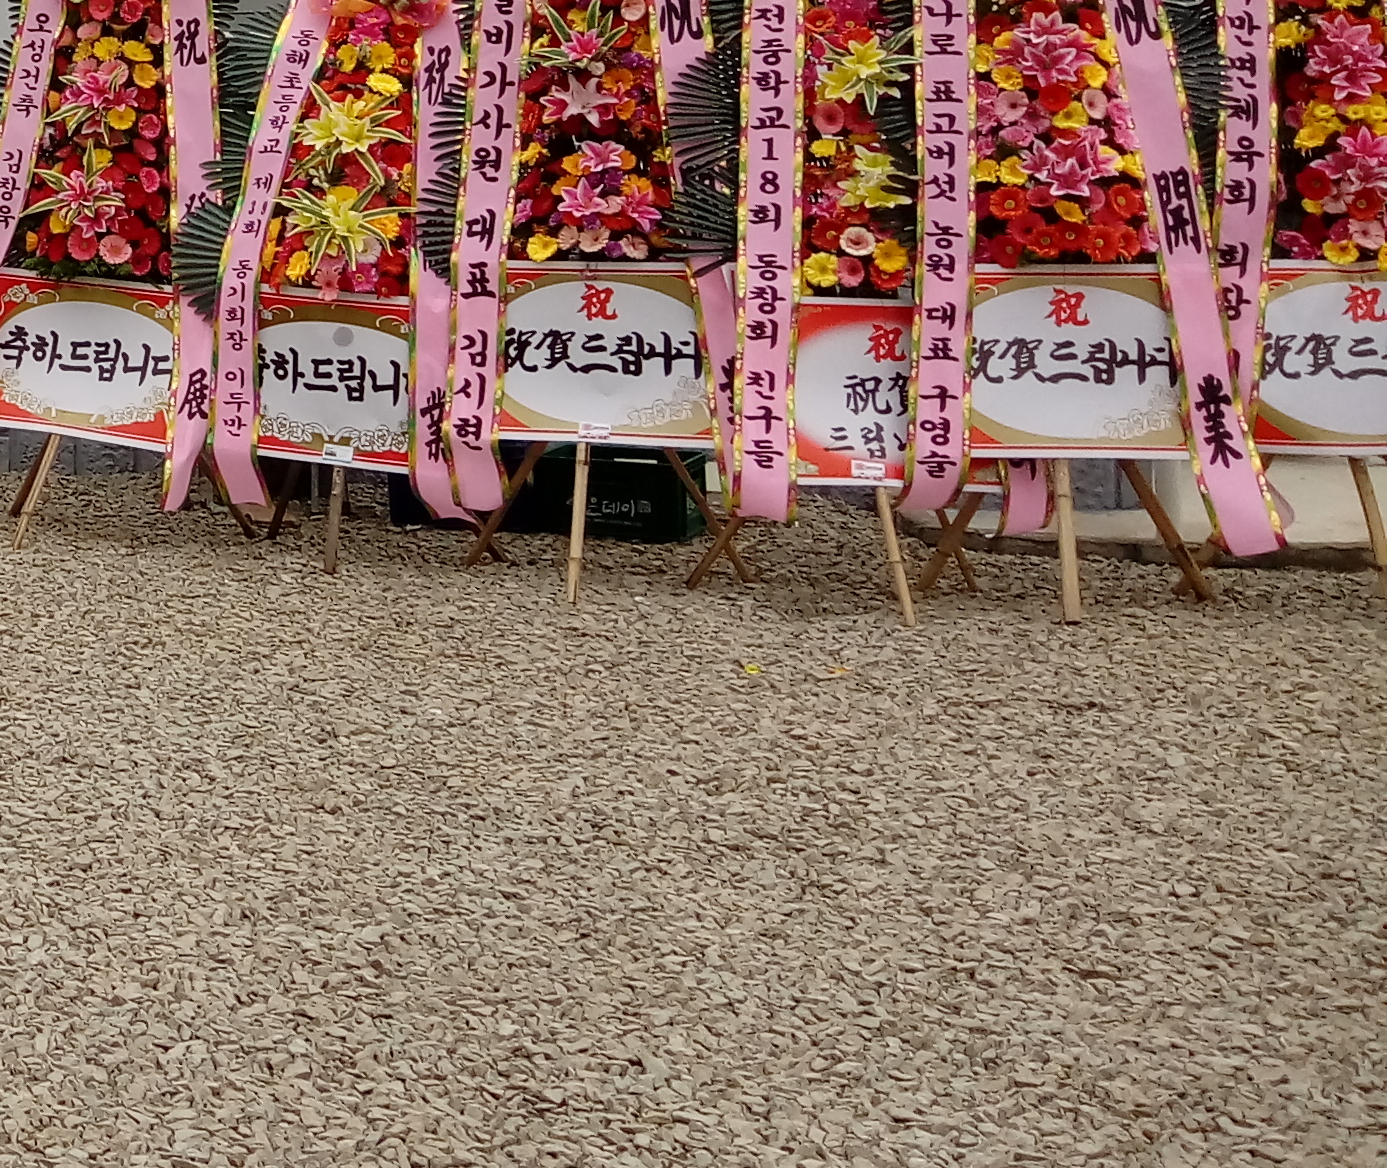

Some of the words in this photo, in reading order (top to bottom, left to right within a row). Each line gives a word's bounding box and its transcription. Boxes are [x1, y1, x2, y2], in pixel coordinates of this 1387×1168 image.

[12, 12, 53, 119] 오성건축
[172, 17, 207, 68] 祝
[257, 28, 320, 156] 동해초등학교
[924, 78, 965, 203] 표고버섯
[459, 207, 497, 301] 대표
[923, 219, 965, 283] 농원
[223, 258, 254, 353] 동기회장
[576, 283, 619, 321] 祝
[745, 252, 789, 350] 동창회
[920, 301, 960, 364] 대표
[1043, 287, 1091, 328] 祝
[1152, 165, 1202, 255] 開
[1194, 373, 1245, 470] 業
[1342, 283, 1387, 324] 祝
[863, 322, 907, 364] 祝
[1262, 332, 1387, 381] 祝賀드
[178, 368, 210, 421] 展
[221, 367, 251, 438] 이두만
[452, 328, 488, 452] 김시현
[743, 369, 784, 470] 친구들
[915, 384, 960, 480] 구영술
